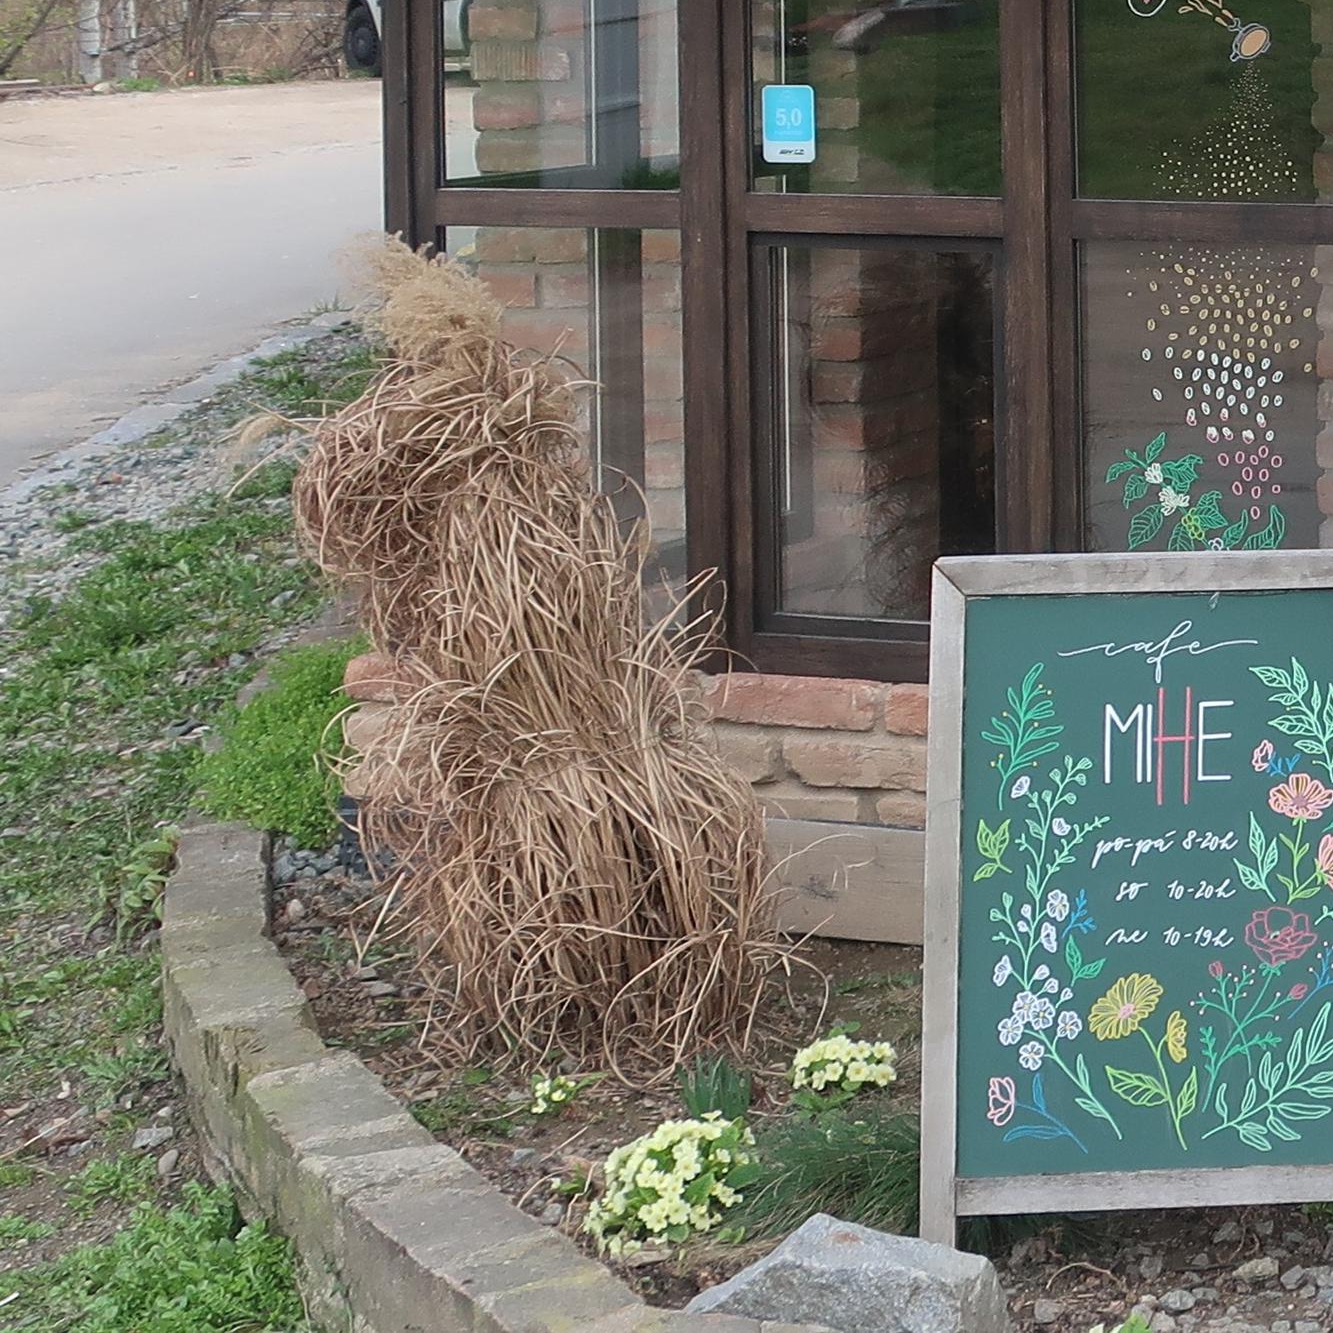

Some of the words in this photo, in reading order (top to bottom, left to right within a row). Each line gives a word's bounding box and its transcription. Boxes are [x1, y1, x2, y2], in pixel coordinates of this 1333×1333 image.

[1056, 620, 1259, 684] cafe
[1102, 685, 1236, 806] MIHE
[1091, 830, 1176, 869] po-pá
[1181, 831, 1240, 852] 8-20h
[1115, 881, 1149, 902] so
[1168, 879, 1238, 900] 10-20h
[1105, 929, 1149, 947] ne
[1162, 926, 1236, 949] 10-19h
